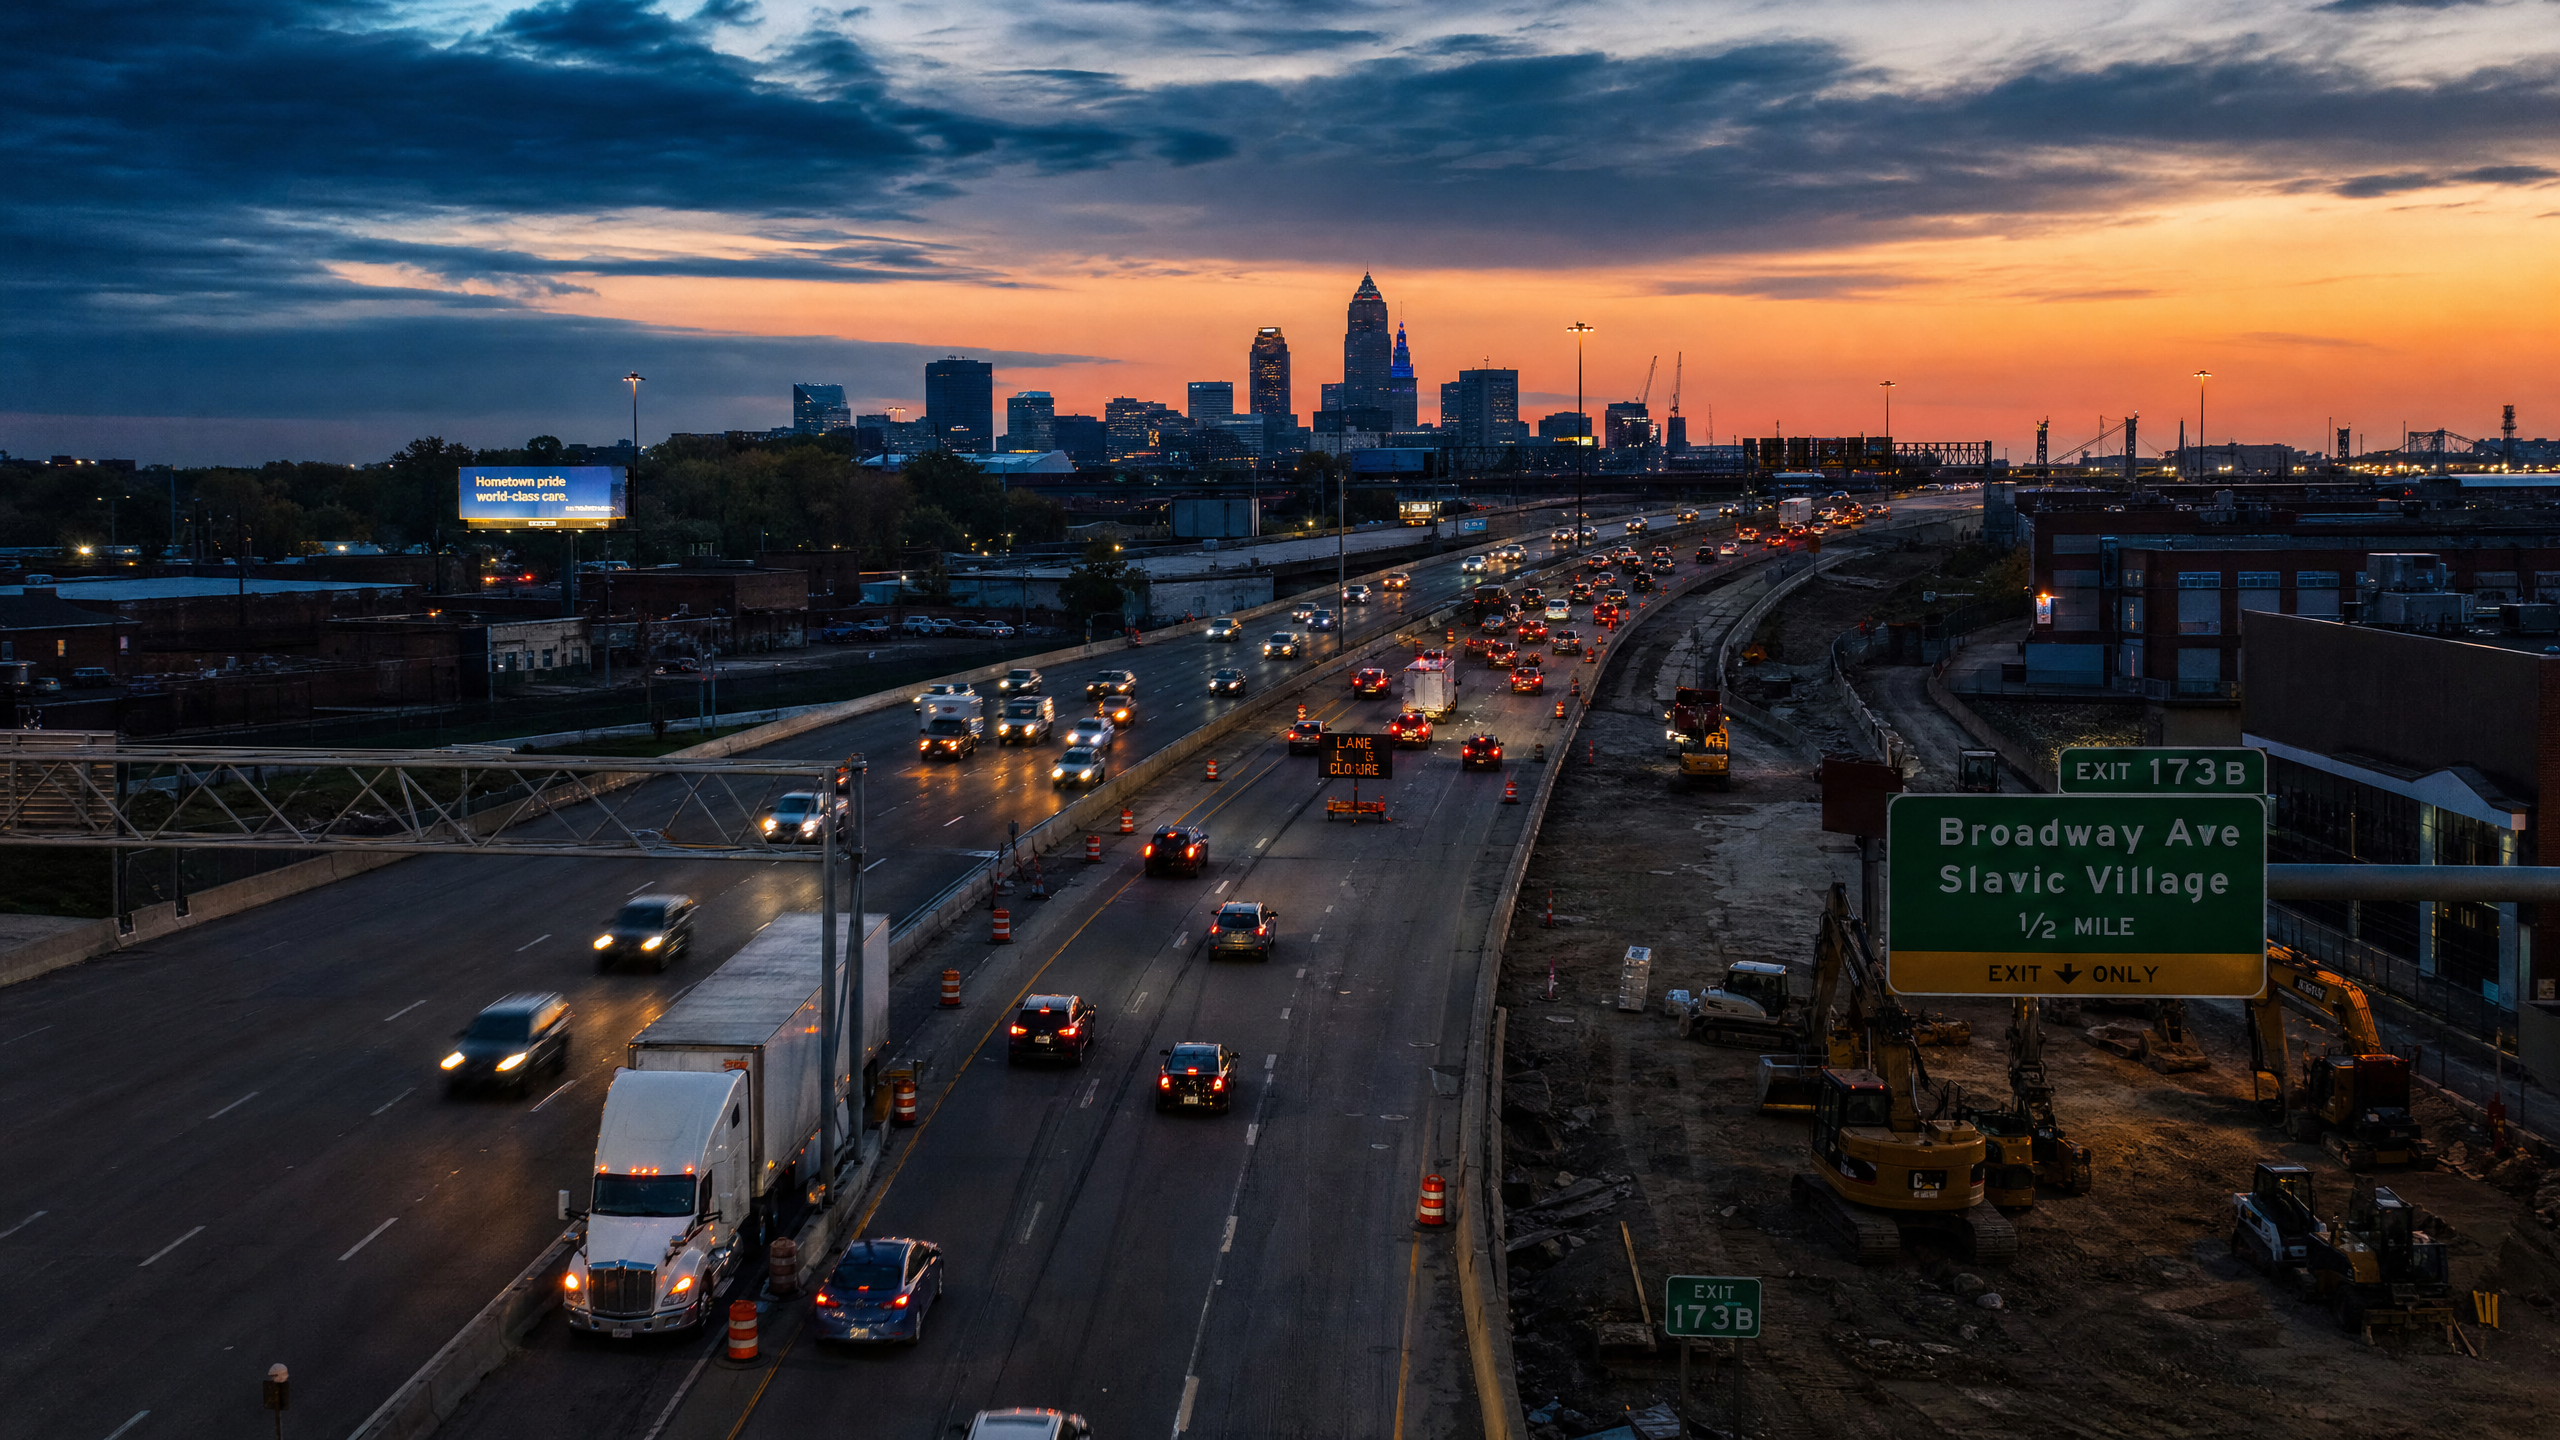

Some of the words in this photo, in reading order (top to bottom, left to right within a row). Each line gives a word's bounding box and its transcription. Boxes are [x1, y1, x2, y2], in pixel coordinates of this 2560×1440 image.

[476, 476, 535, 488] Hometown
[537, 476, 567, 489] pride
[476, 490, 540, 502] world-class
[541, 492, 569, 502] care.
[1336, 736, 1372, 750] LANE
[2076, 762, 2131, 780] EXIT
[2150, 758, 2246, 786] 173B
[1940, 817, 2145, 855] Broadway
[2165, 818, 2240, 847] Ave
[1939, 864, 2066, 894] Slavic
[2086, 865, 2229, 904] Village
[2075, 917, 2135, 936] MILE
[1988, 965, 2042, 983] EXIT
[2092, 965, 2160, 984] ONLY
[1694, 1284, 1735, 1300] EXIT
[1674, 1304, 1754, 1331] 173B
